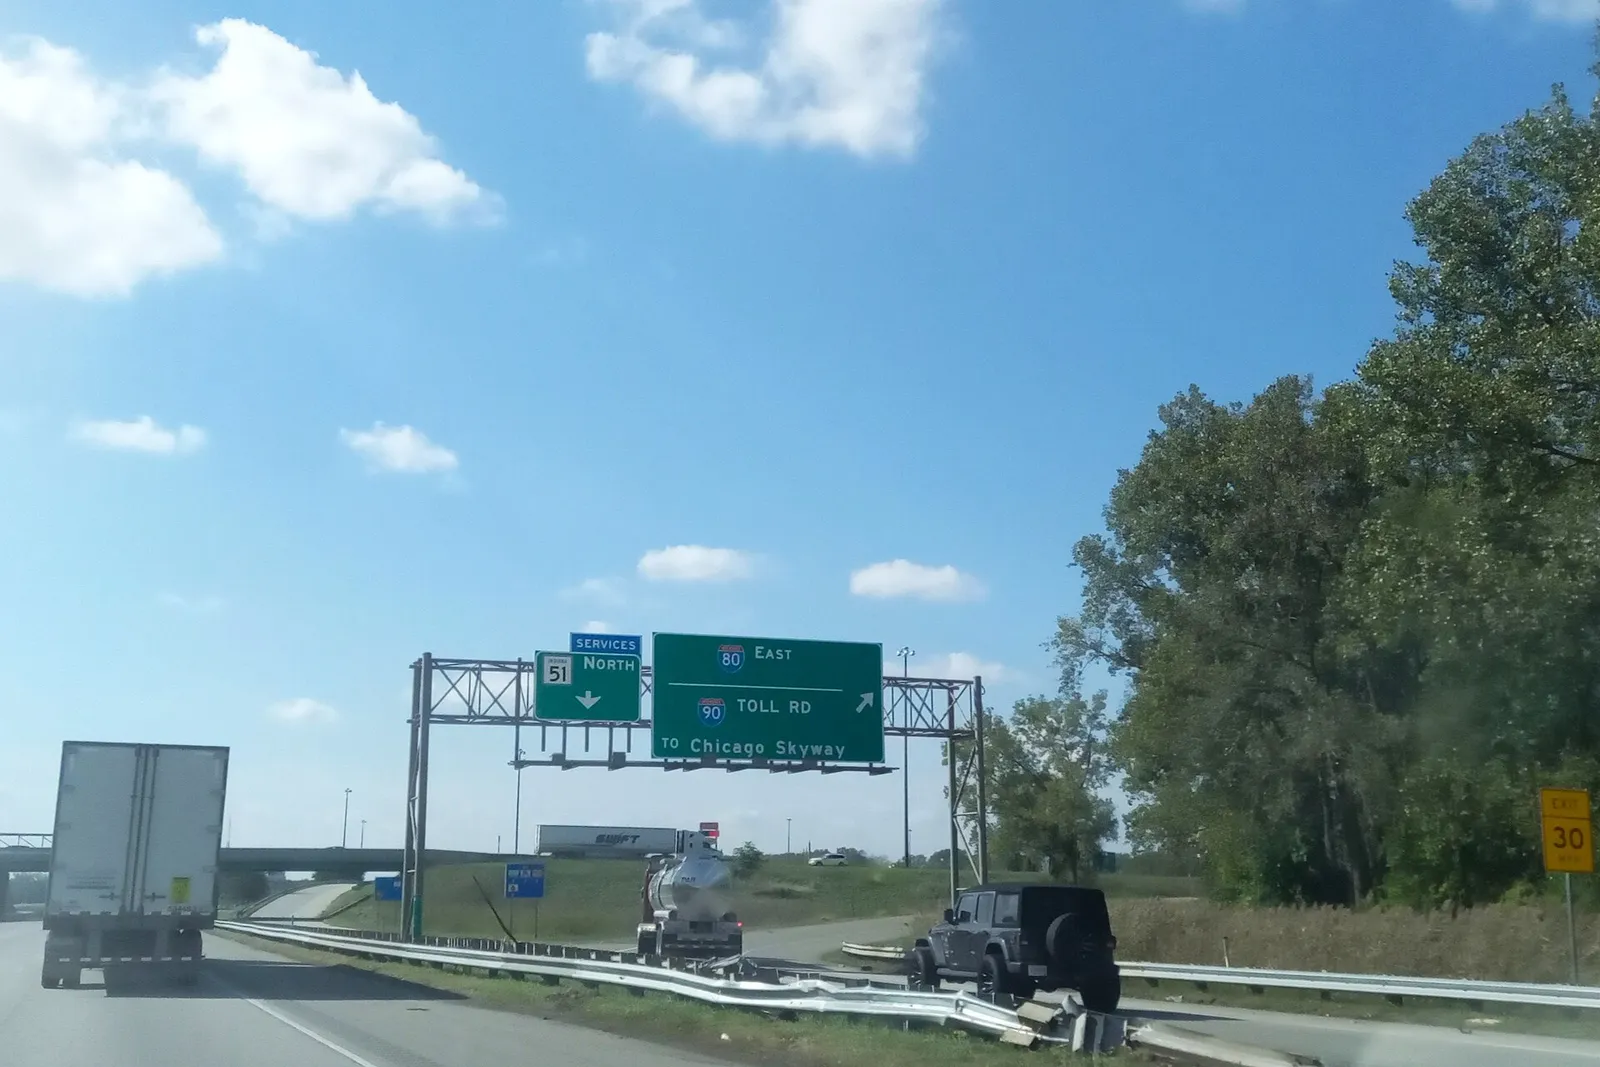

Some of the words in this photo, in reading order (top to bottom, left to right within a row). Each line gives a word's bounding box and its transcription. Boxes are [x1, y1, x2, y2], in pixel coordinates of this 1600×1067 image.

[576, 638, 637, 650] SERVICES
[722, 652, 740, 666] 80
[755, 646, 792, 660] EAST
[583, 655, 635, 671] NORTH
[549, 666, 566, 682] 51
[702, 706, 721, 720] 90
[737, 699, 779, 713] TOLL
[789, 700, 811, 714] RD
[661, 737, 679, 749] TO
[690, 738, 765, 757] Chicago
[776, 740, 845, 759] Skyway
[595, 833, 640, 844] SWIFT
[1553, 826, 1584, 849] 30
